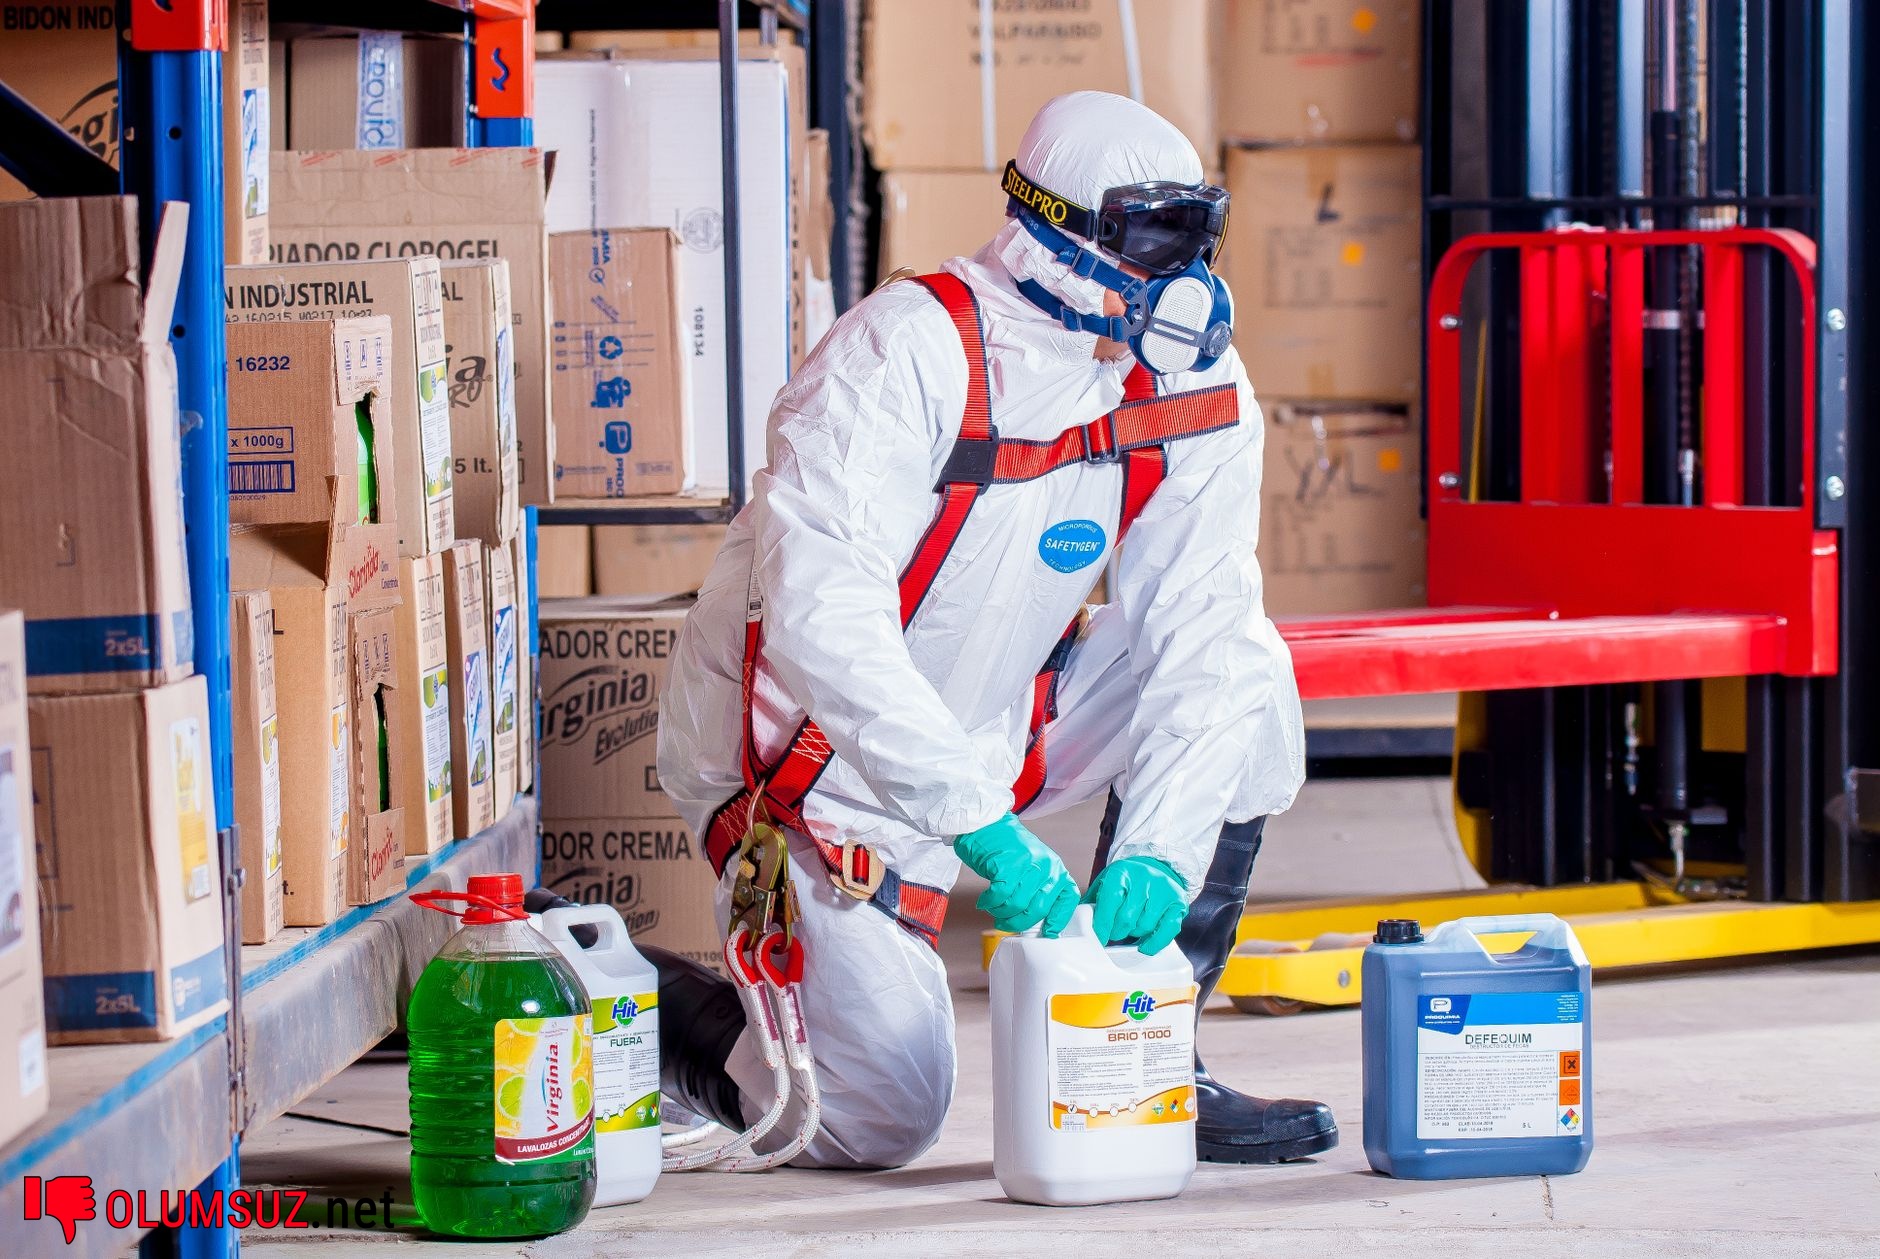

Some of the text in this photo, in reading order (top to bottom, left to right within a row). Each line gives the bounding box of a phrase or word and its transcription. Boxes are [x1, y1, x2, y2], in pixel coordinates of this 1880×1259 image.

[4, 6, 116, 30] BIDON IND
[1005, 167, 1067, 225] STEELPRO
[240, 280, 374, 308] INDUSTRIAL
[235, 355, 291, 372] 16232
[230, 435, 285, 449] x 1000g
[454, 458, 466, 474] 5
[1044, 537, 1098, 552] SAFETYGEN
[104, 636, 150, 657] 2x5L
[616, 629, 677, 659] CRE
[540, 669, 649, 739] irginia
[594, 712, 659, 759] Evolutio
[602, 831, 692, 860] CREMA
[611, 999, 639, 1020] Hit
[1122, 994, 1156, 1014] Hit
[610, 1035, 643, 1048] FUERA
[1108, 1031, 1139, 1042] BRIO
[1142, 1029, 1172, 1040] 1000
[1465, 1033, 1532, 1045] DEFEQUIM
[546, 1043, 563, 1133] Virginia
[517, 1140, 558, 1153] LAVALOZAS
